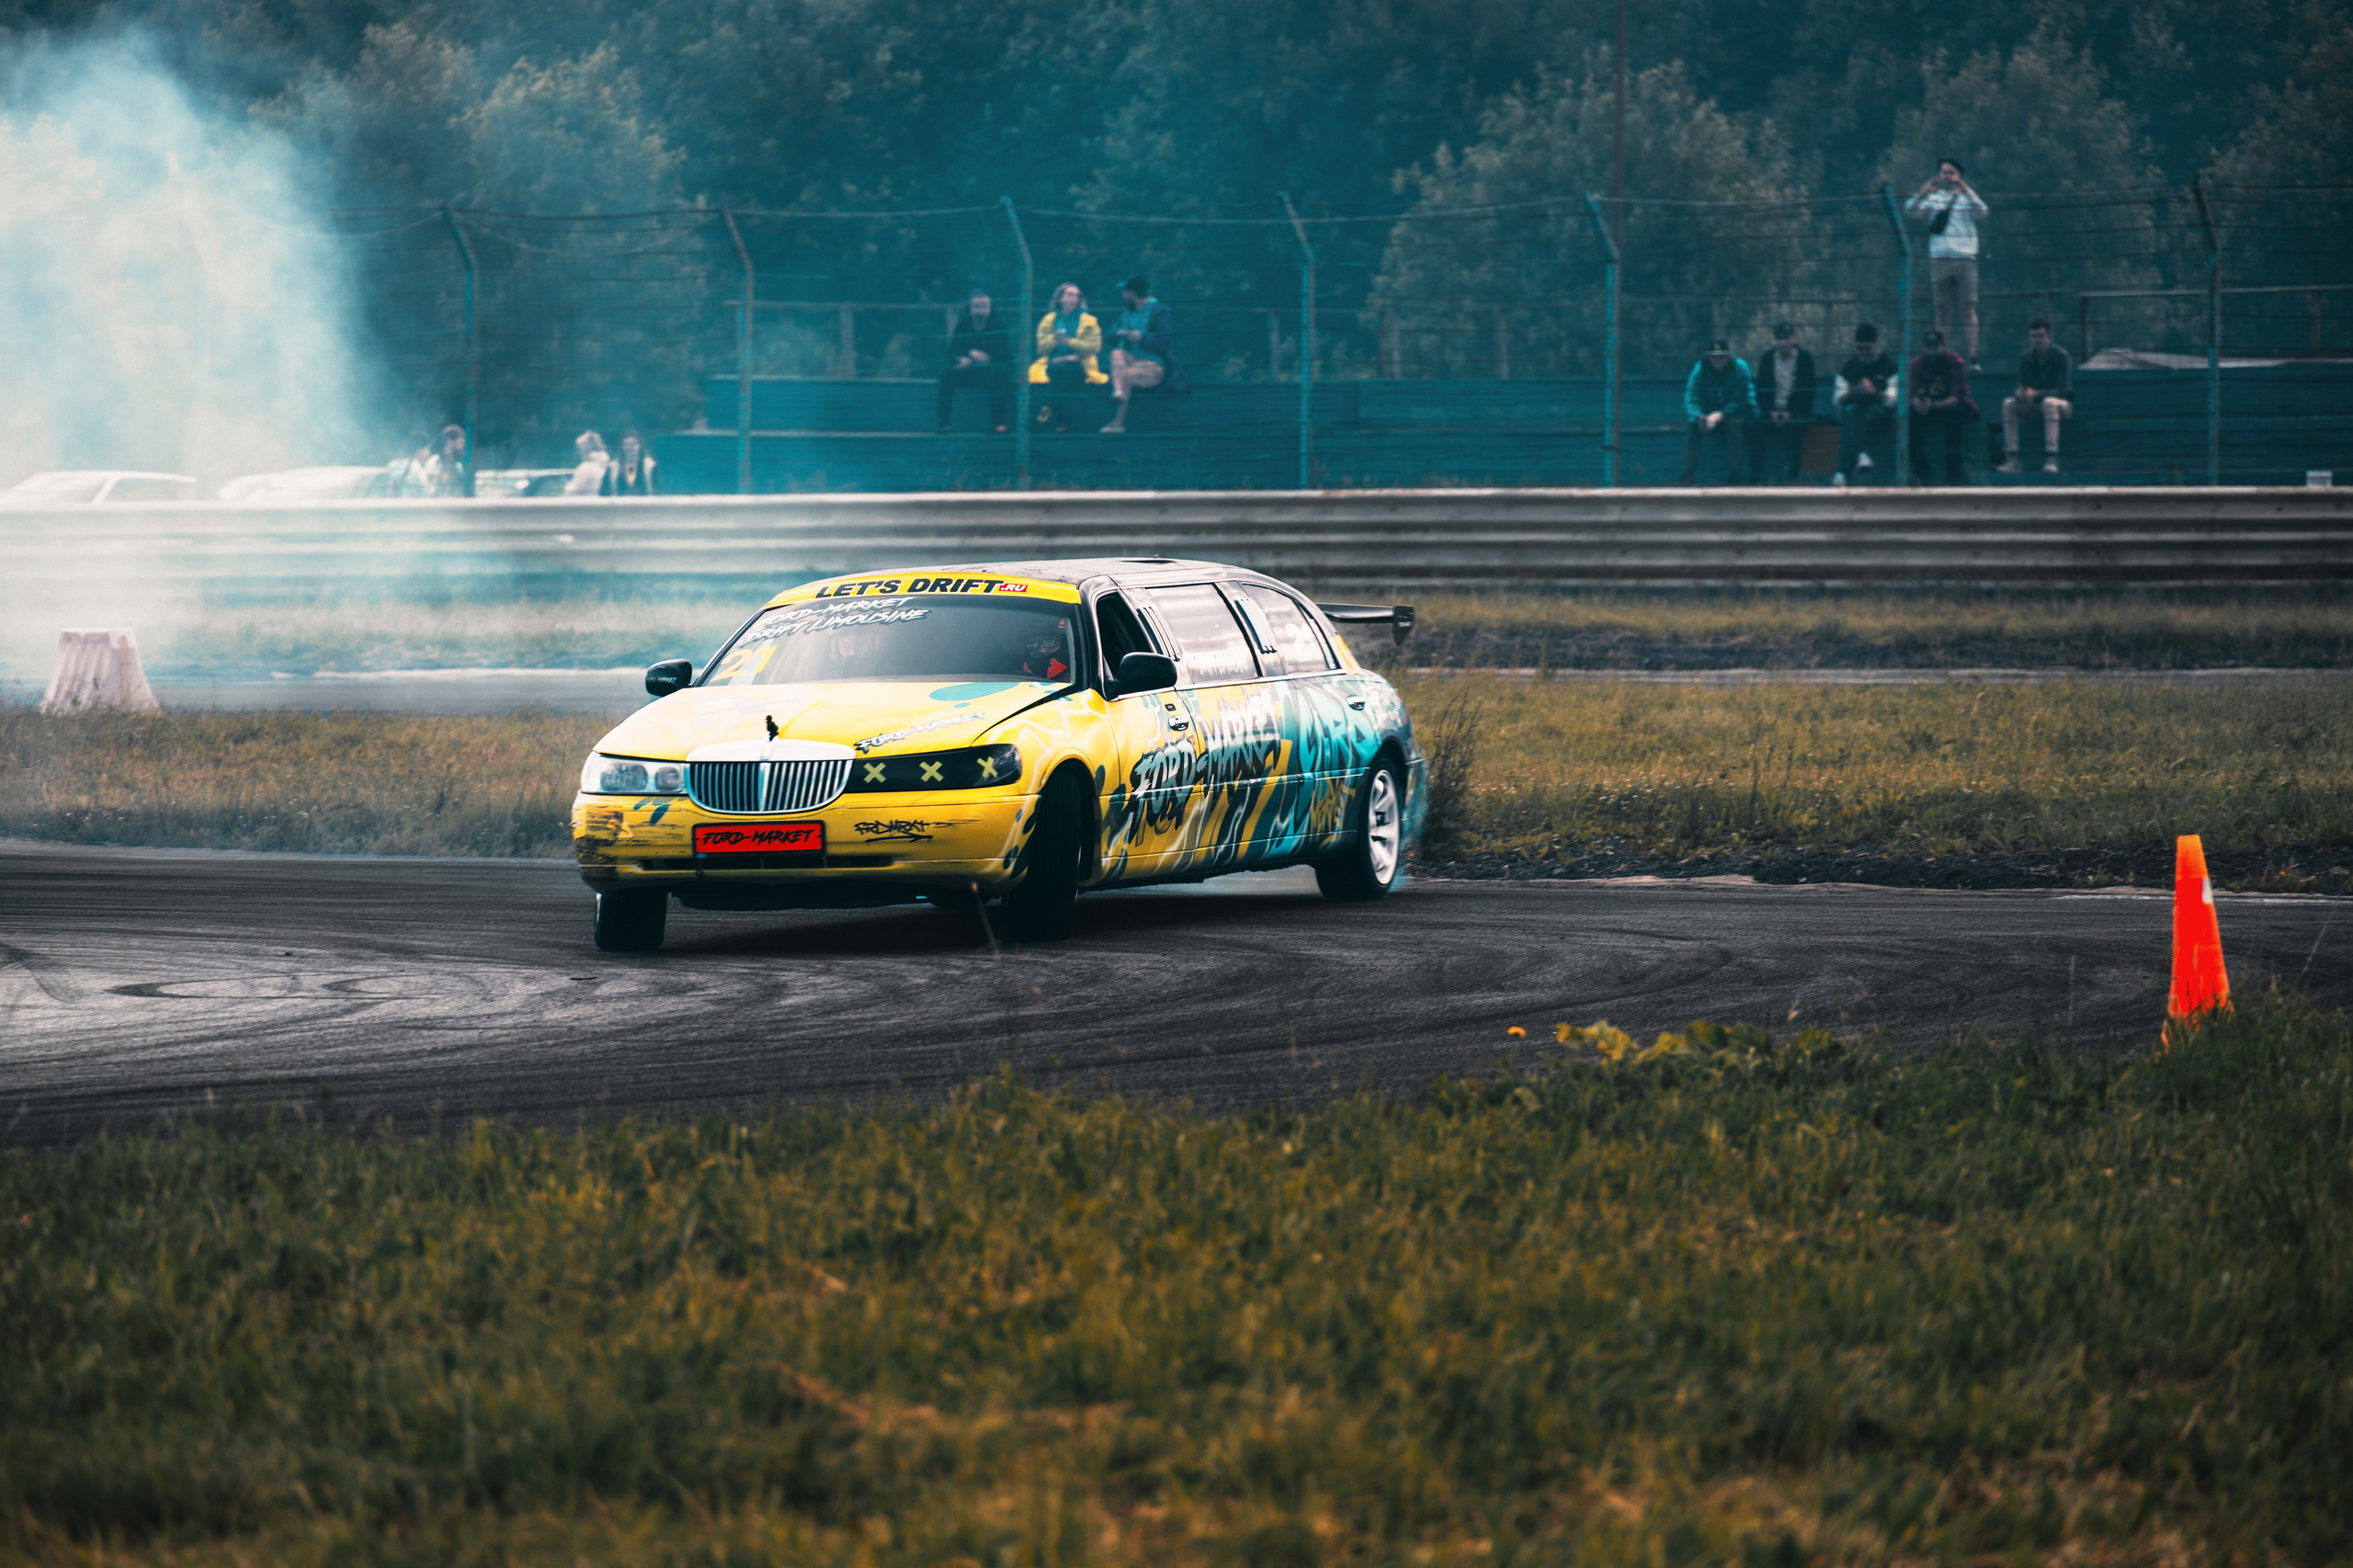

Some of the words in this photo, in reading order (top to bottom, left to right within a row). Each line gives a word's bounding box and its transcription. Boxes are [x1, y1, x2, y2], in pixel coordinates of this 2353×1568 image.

[815, 579, 903, 599] LET'S
[806, 608, 929, 633] LIMOUSINE
[710, 644, 779, 682] 21
[702, 829, 815, 846] FORD-MARKET
